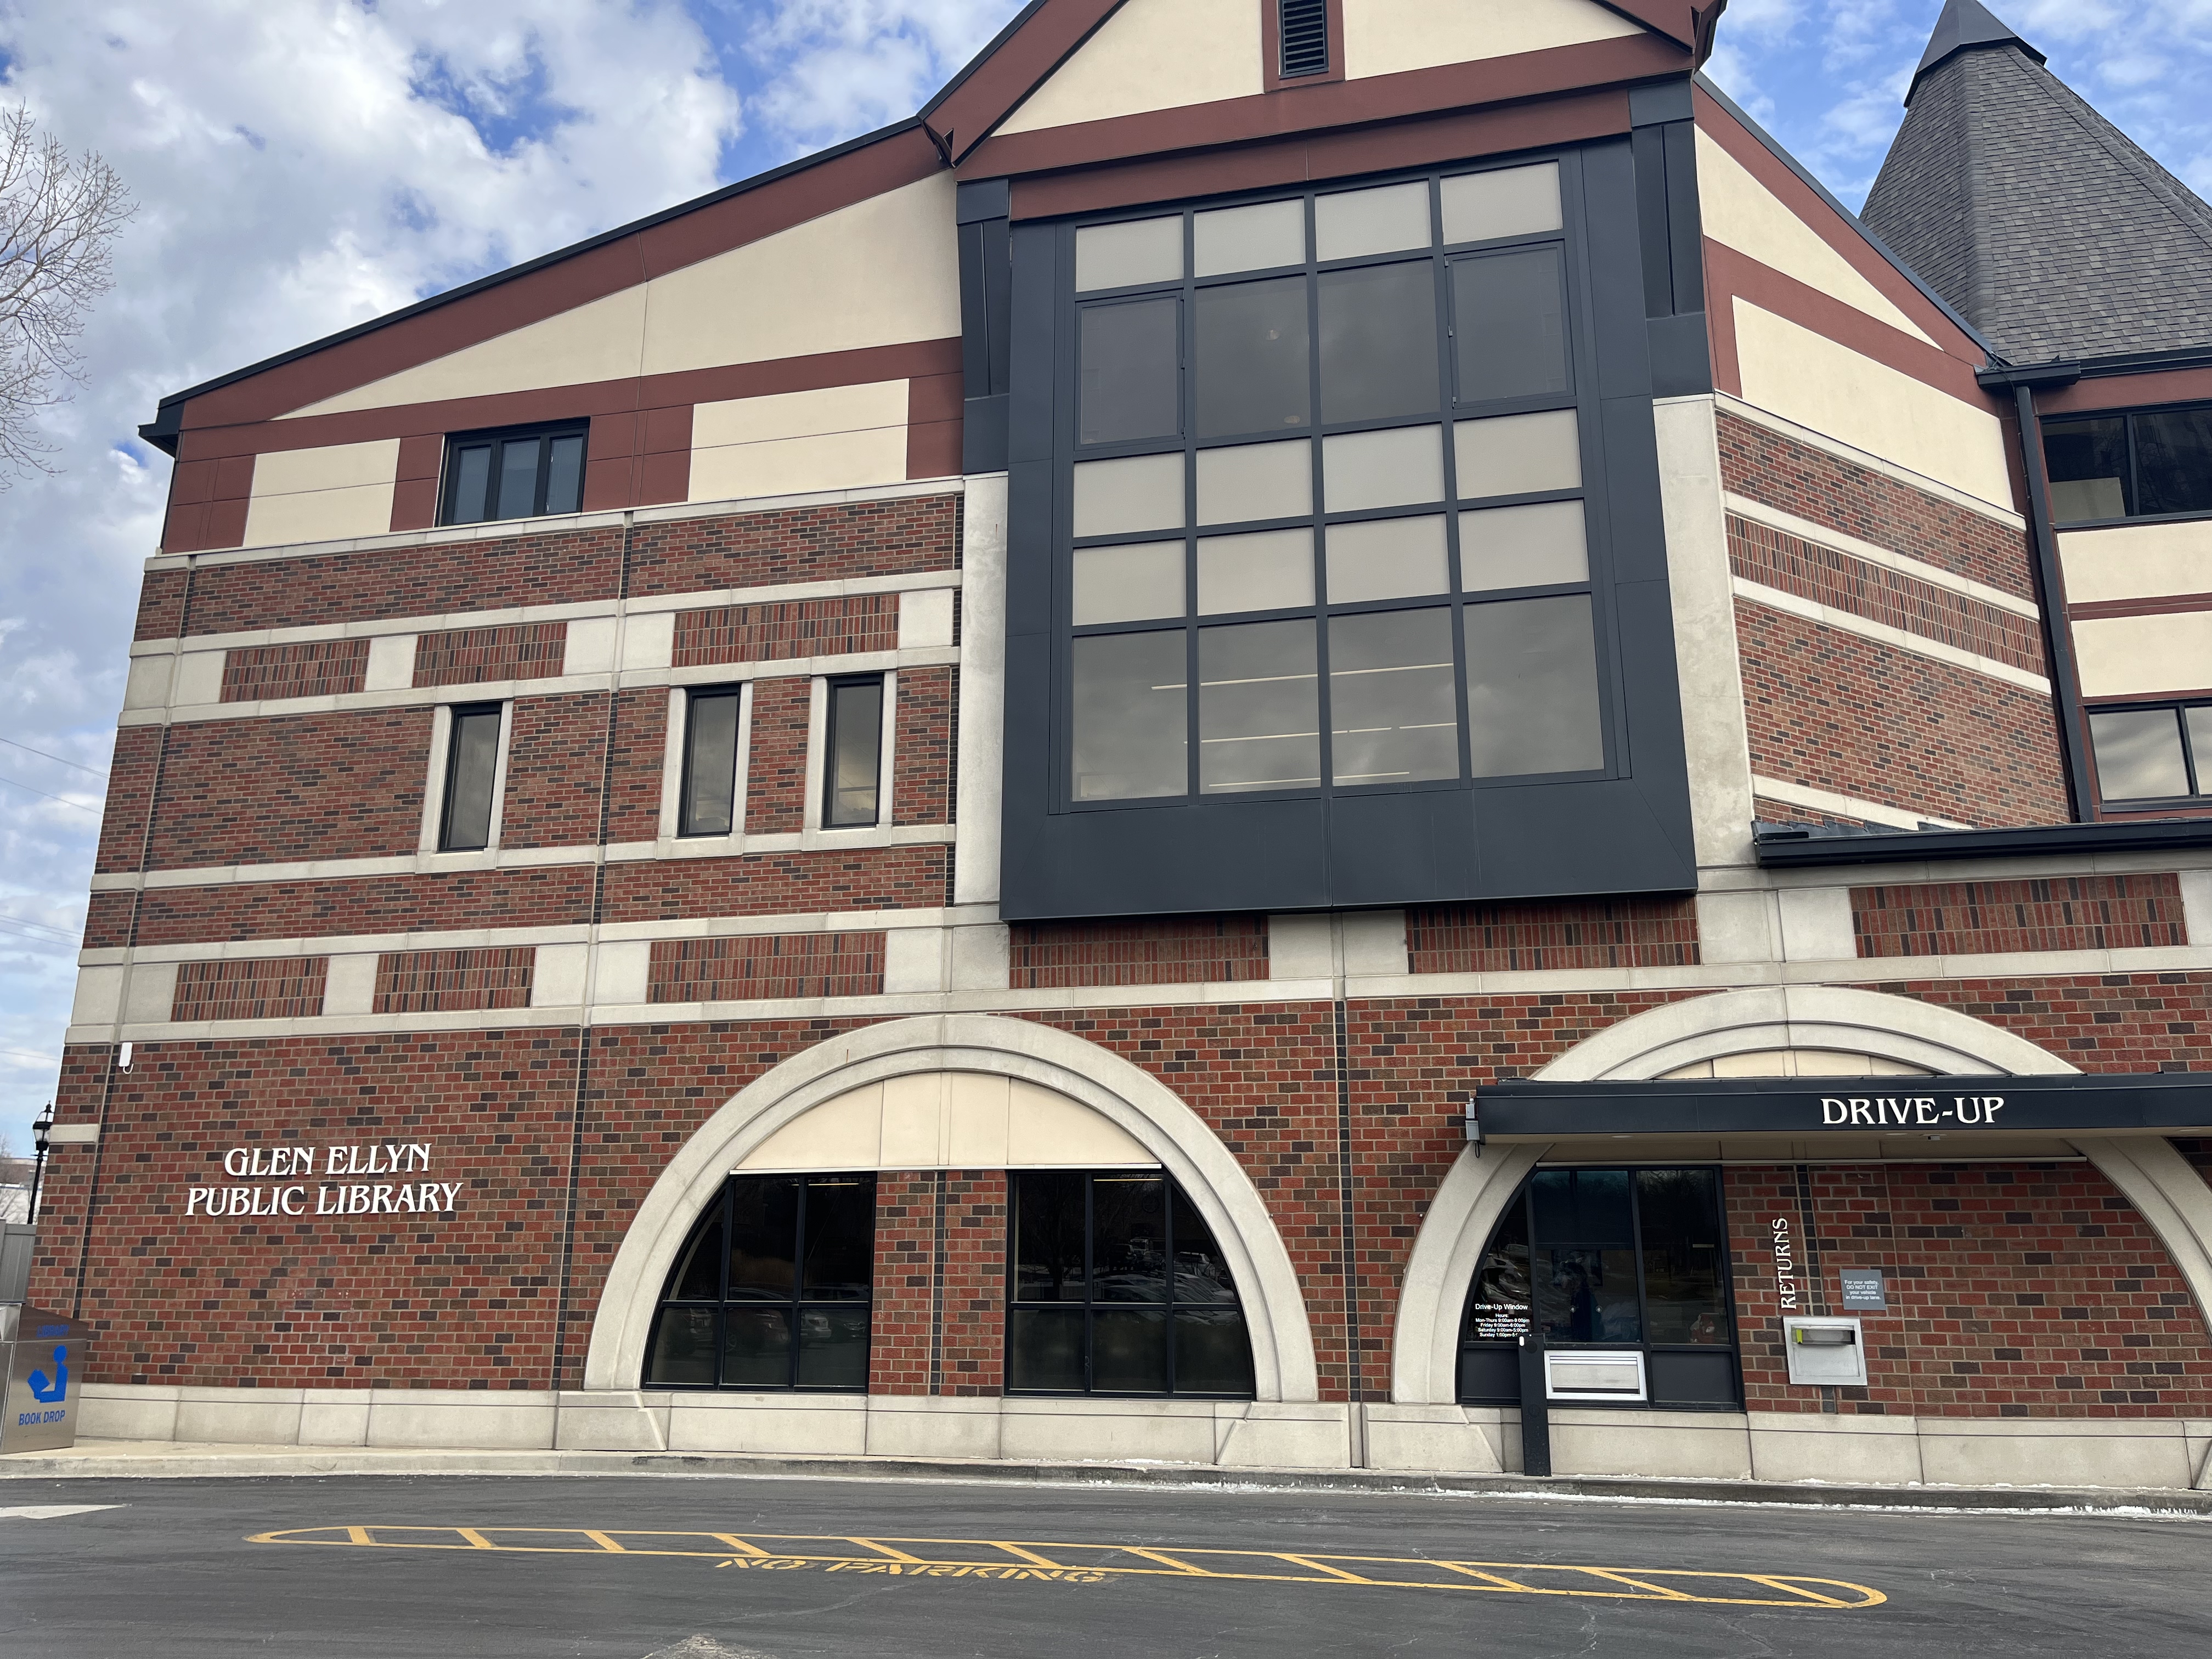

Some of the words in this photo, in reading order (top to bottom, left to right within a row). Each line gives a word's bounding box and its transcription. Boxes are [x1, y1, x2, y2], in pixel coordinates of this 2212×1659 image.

[1820, 1097, 2004, 1124] DRIVE-UP
[224, 1147, 316, 1176] GLEN
[325, 1143, 432, 1175] ELLYN
[185, 1186, 305, 1216] PUBLIC
[315, 1182, 464, 1215] LIBRARY
[1773, 1217, 1797, 1310] RETURNS
[36, 1324, 70, 1338] LIBRARY
[19, 1411, 42, 1426] BOOK
[43, 1409, 65, 1424] DROP
[715, 1558, 808, 1570] NO
[825, 1561, 1107, 1582] PARKING
